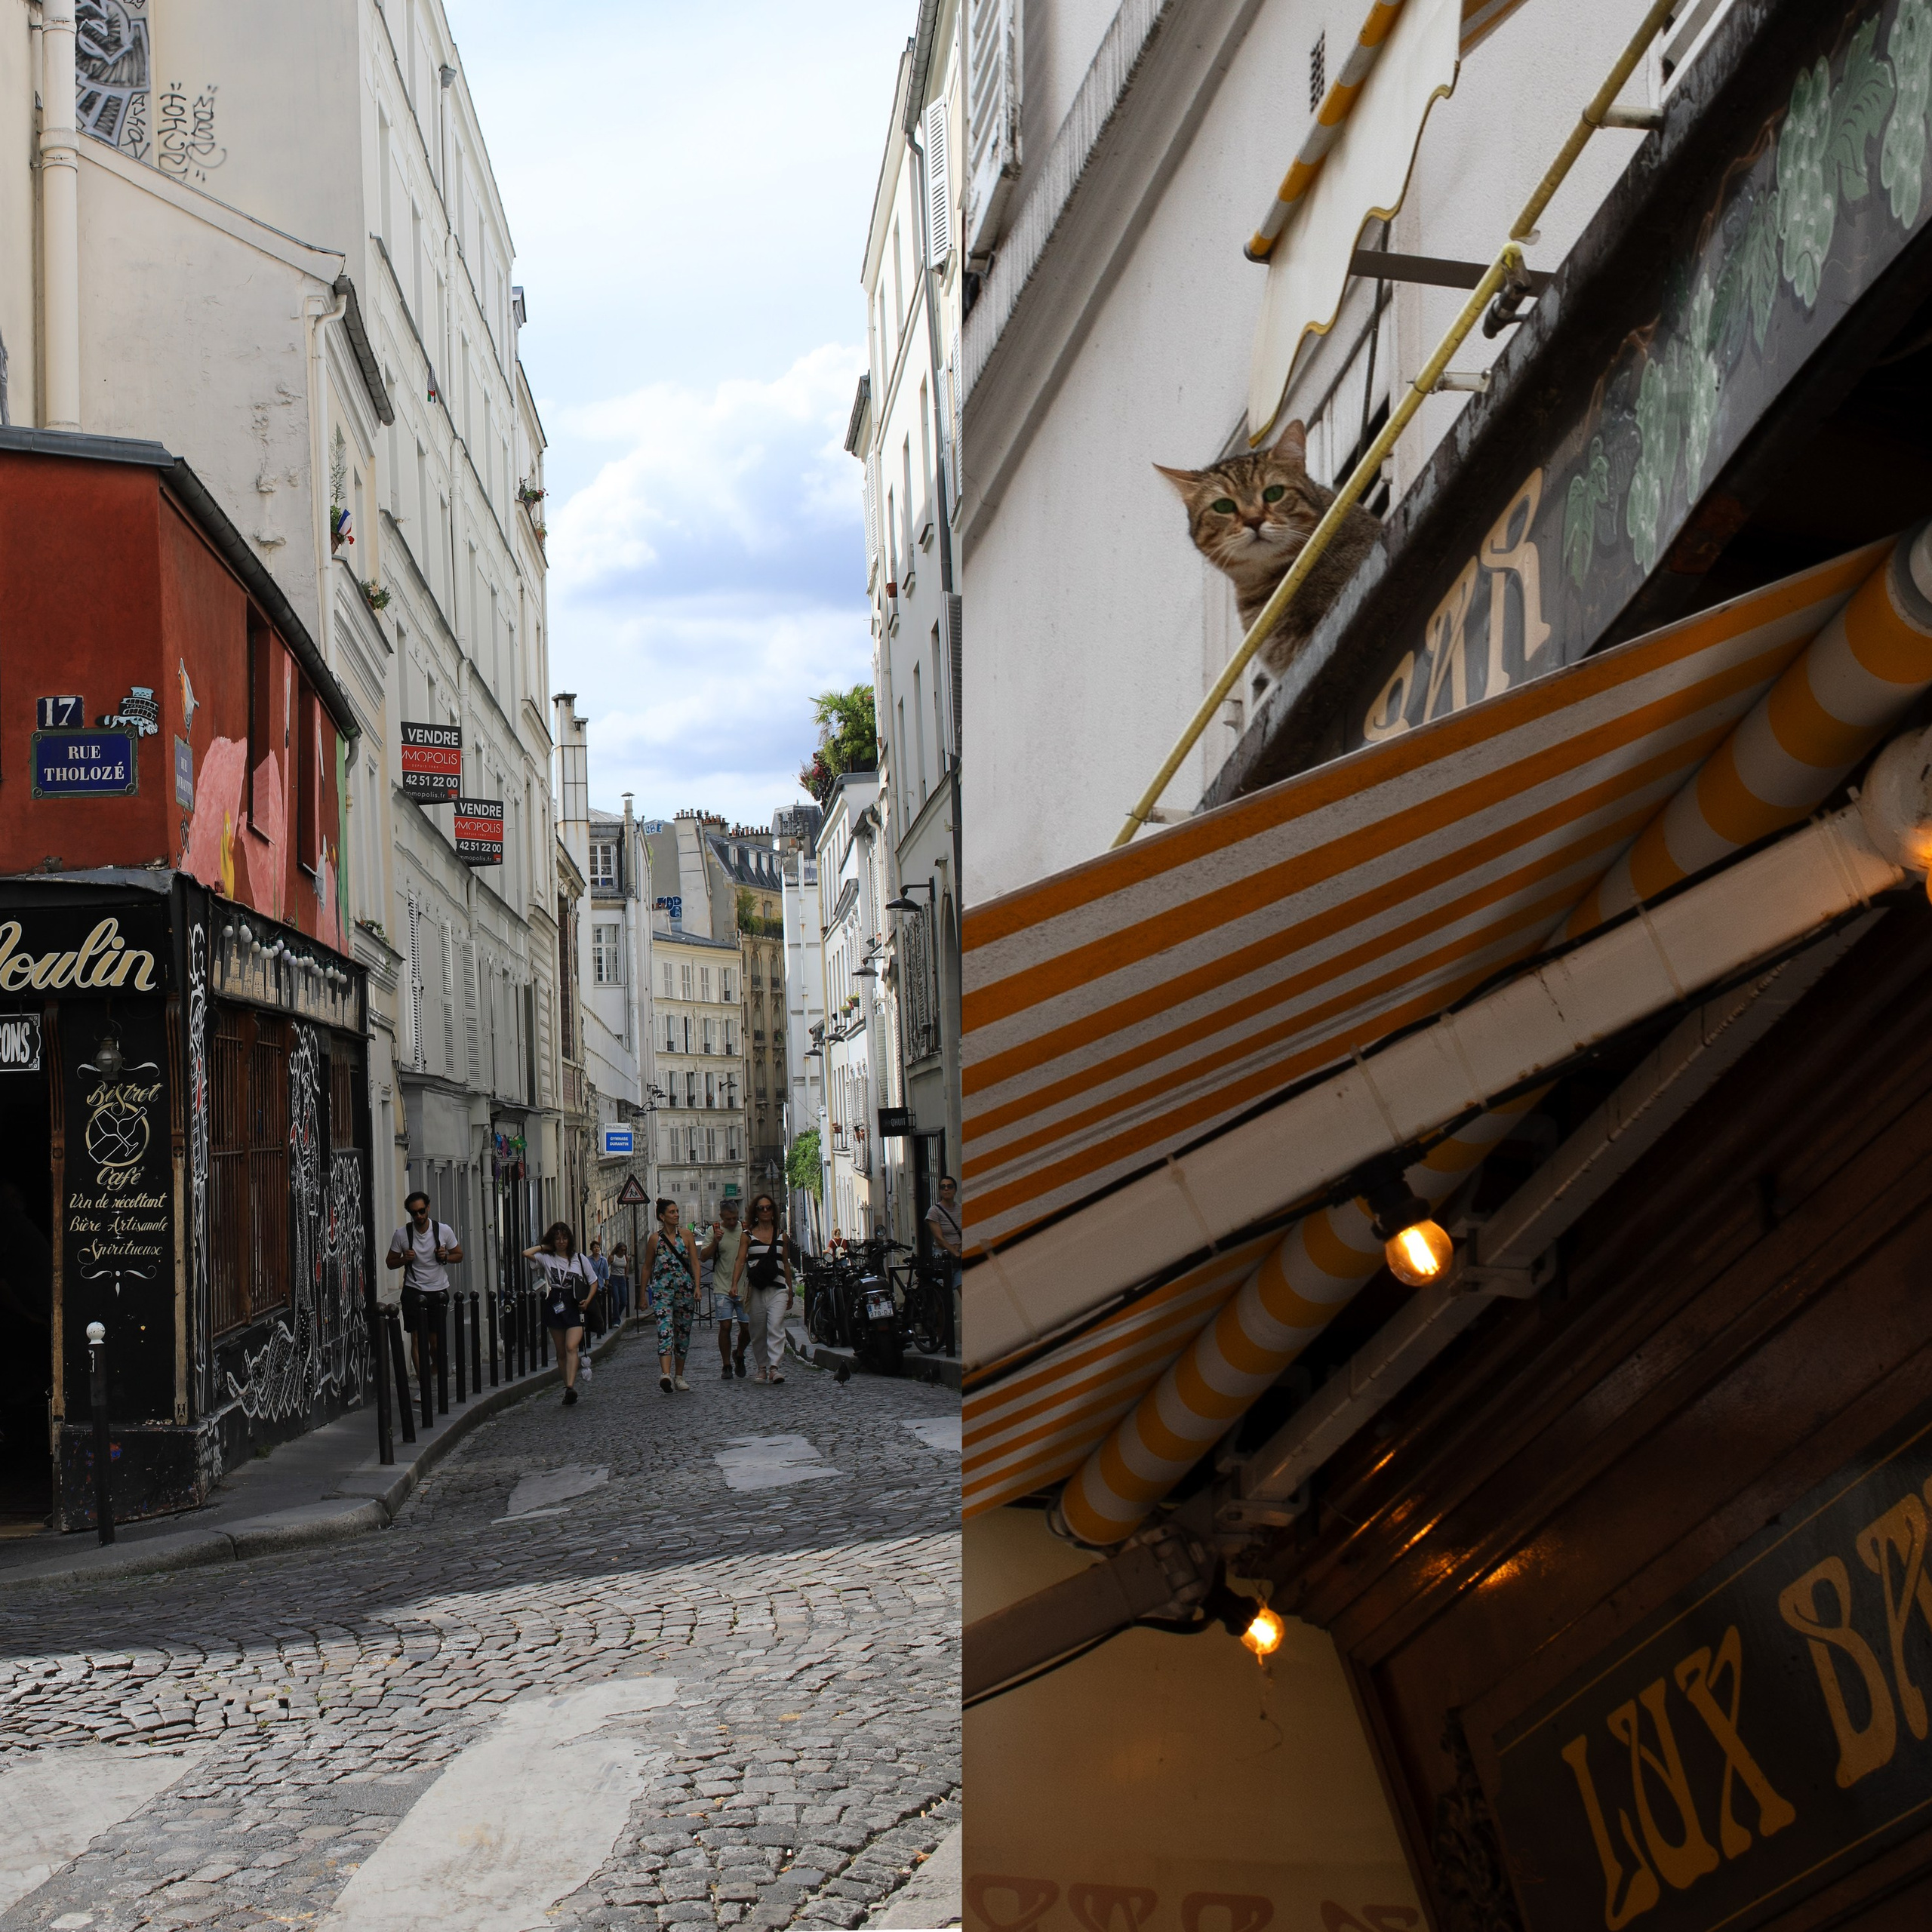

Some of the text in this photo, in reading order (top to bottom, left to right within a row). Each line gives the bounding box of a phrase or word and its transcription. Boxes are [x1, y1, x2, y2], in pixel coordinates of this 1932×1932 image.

[45, 697, 76, 727] 17
[408, 728, 459, 746] VENDRE
[68, 745, 101, 759] RUE
[44, 761, 125, 781] THOLOZÉ
[405, 774, 458, 788] 42 51 22 00
[460, 802, 502, 817] VENDRE
[460, 841, 501, 853] 42 51 22 00
[0, 1021, 30, 1063] ONS
[97, 1166, 146, 1191] Café
[69, 1192, 168, 1209] Vin de récoltant
[69, 1215, 168, 1235] Bière Artisanale
[77, 1238, 163, 1266] Spiritueux
[1560, 1473, 1932, 1932] LUX BA
